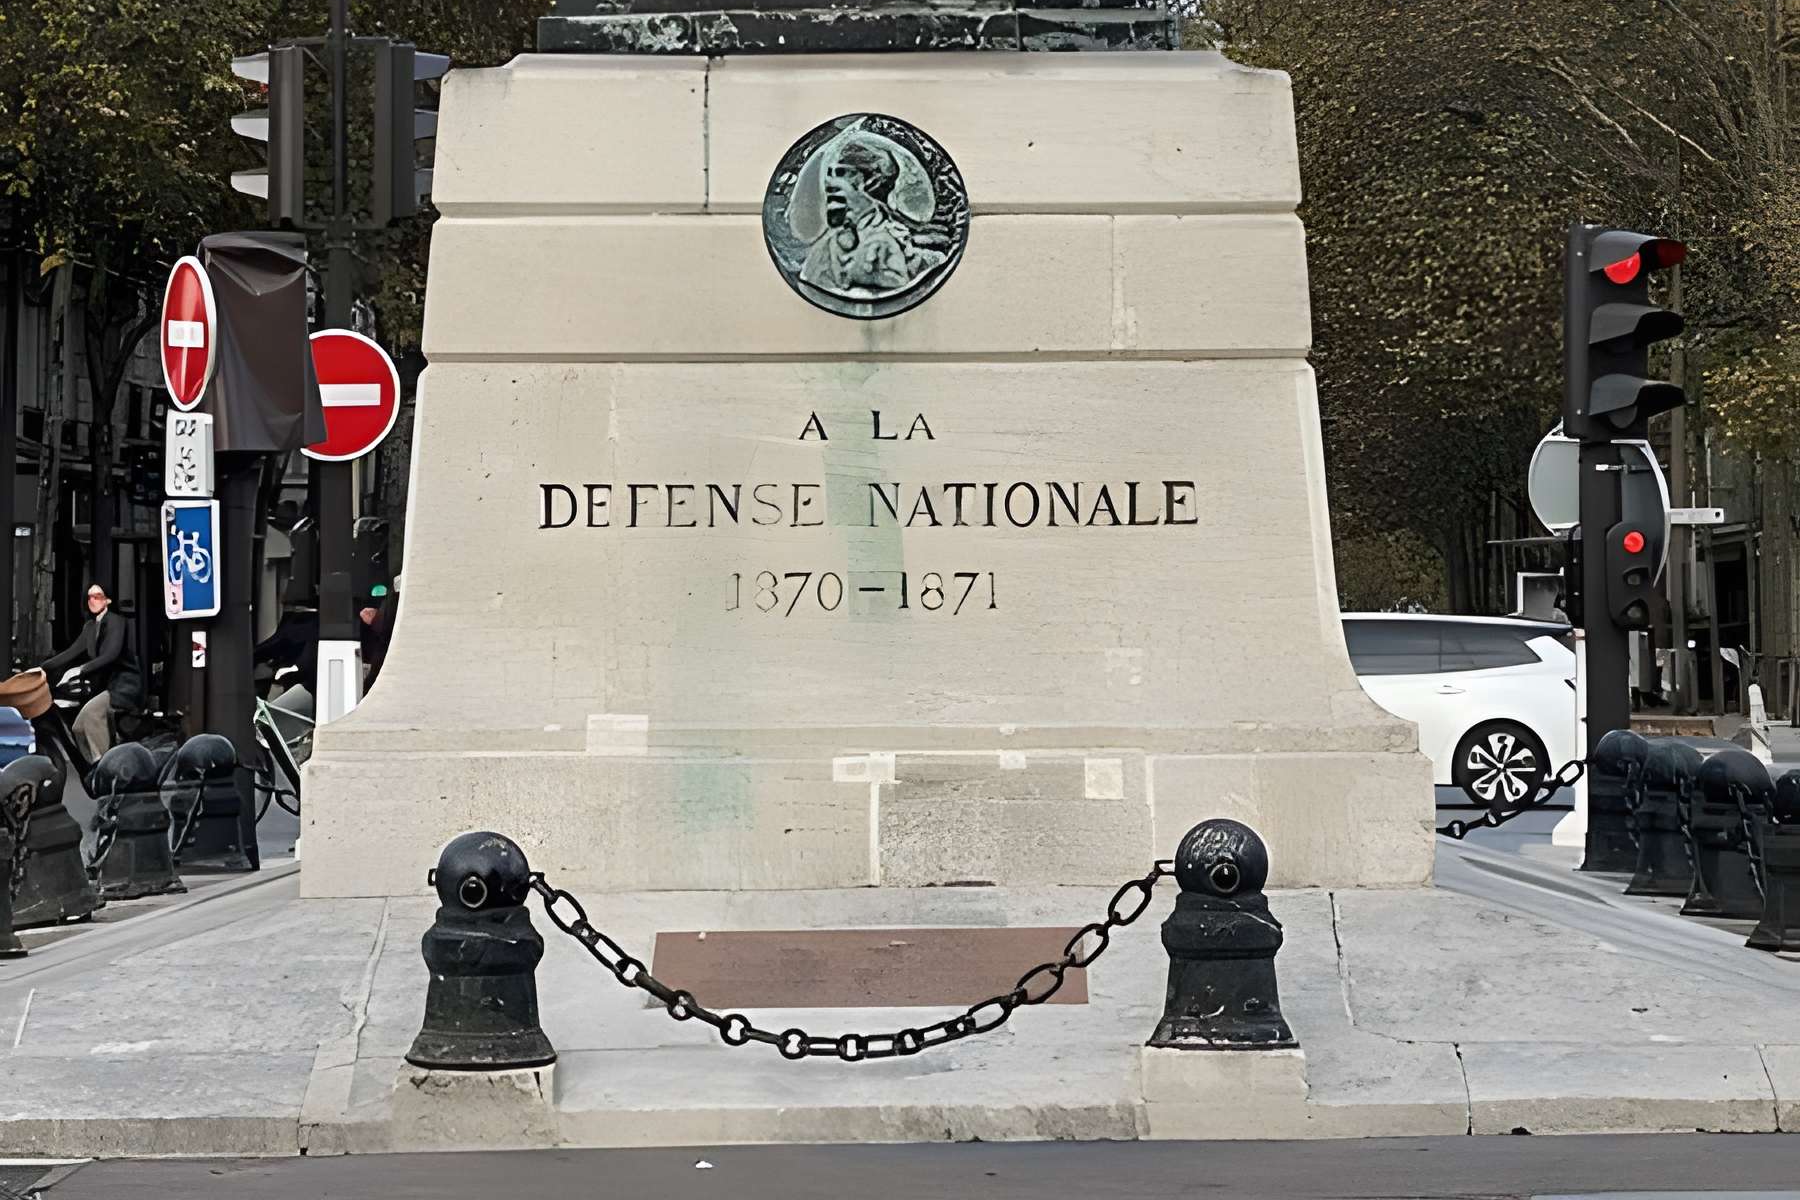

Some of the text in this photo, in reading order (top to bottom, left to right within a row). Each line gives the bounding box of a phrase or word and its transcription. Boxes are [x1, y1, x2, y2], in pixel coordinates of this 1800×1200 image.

[799, 410, 935, 441] A LA
[539, 481, 1199, 530] DEFENSE NATIONALE
